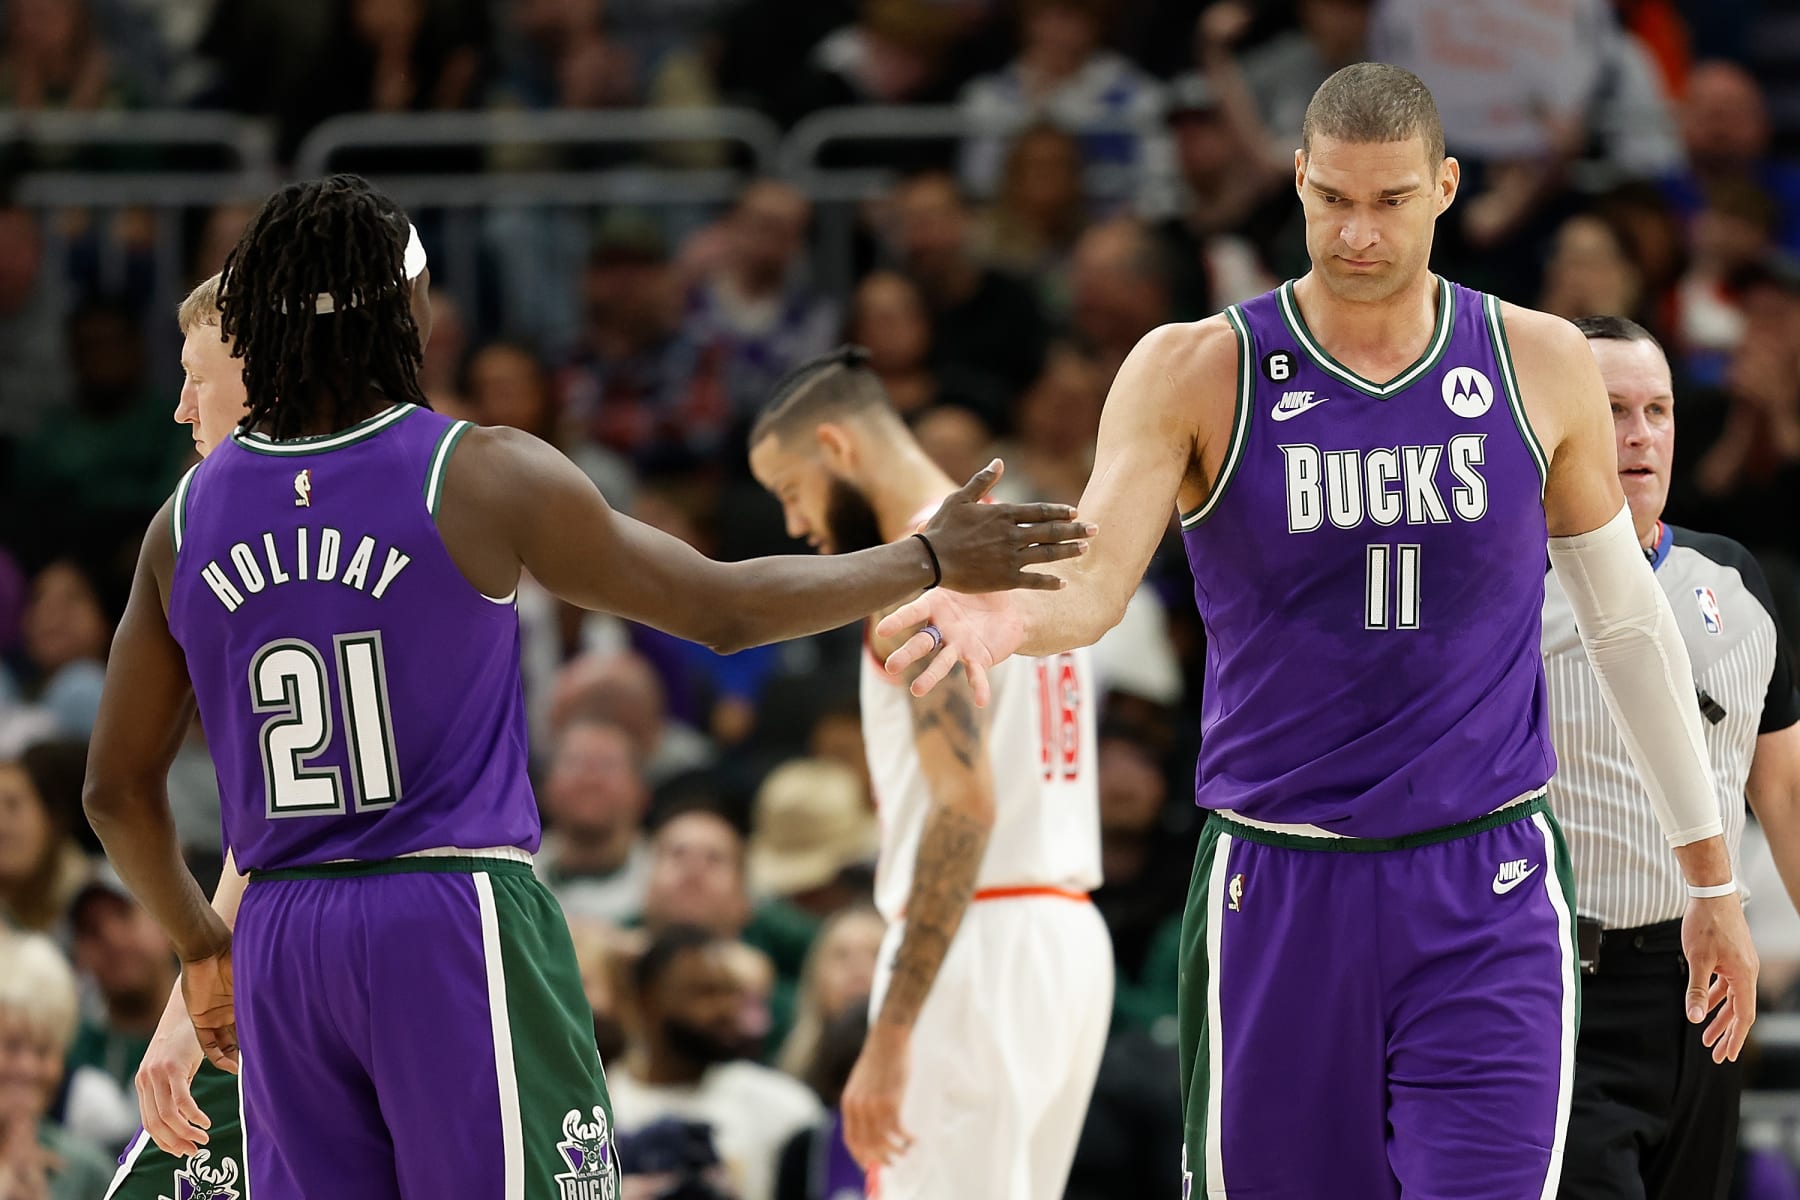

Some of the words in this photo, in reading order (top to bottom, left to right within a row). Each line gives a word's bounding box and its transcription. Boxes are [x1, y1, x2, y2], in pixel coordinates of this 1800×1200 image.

[1269, 354, 1289, 380] 6
[1279, 391, 1315, 409] NIKE
[1277, 434, 1488, 533] BUCKS
[200, 527, 411, 612] HOLIDAY
[1365, 543, 1421, 630] 11
[248, 630, 402, 819] 21
[1499, 859, 1528, 881] NIKE
